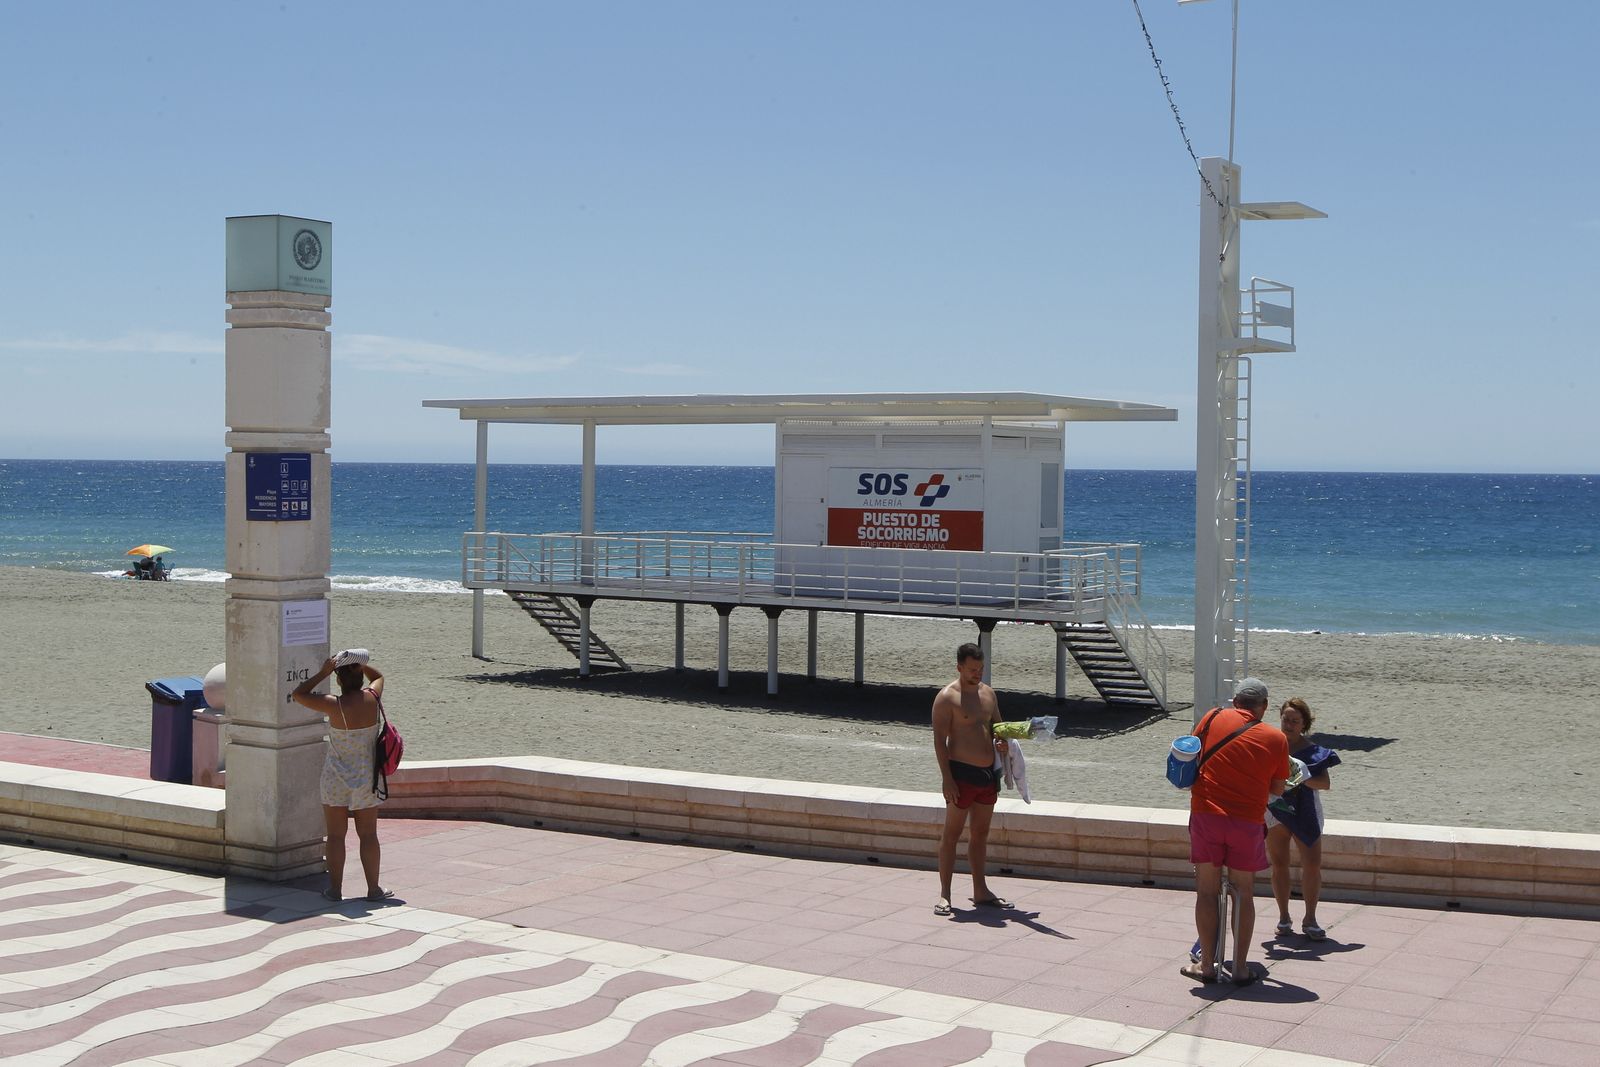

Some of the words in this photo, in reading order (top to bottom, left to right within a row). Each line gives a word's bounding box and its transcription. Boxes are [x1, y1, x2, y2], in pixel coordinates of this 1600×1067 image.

[857, 473, 909, 496] SOS
[863, 498, 902, 507] ALMERÍA
[863, 512, 917, 527] PUESTO
[921, 514, 940, 527] DE
[858, 527, 948, 542] SOCORRISMO
